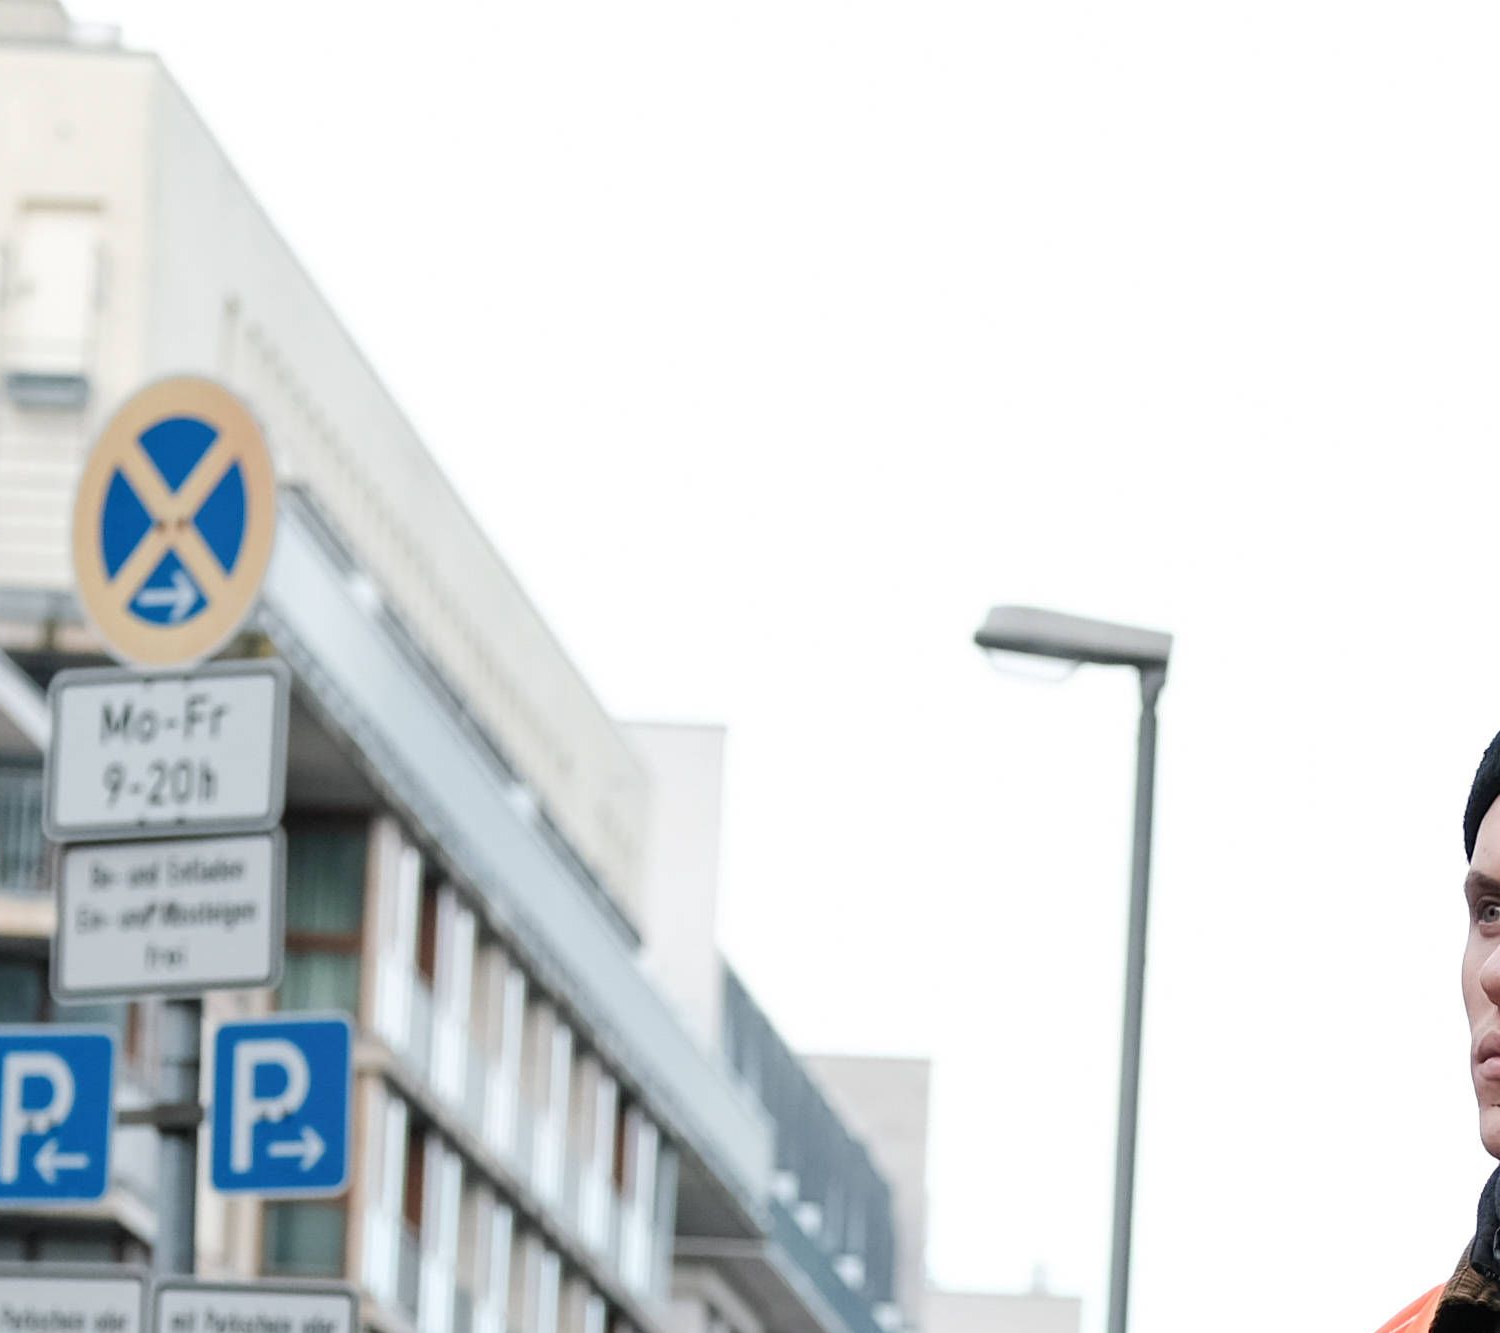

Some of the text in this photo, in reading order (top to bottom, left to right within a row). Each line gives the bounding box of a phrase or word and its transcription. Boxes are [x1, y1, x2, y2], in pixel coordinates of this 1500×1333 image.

[101, 693, 228, 742] Mo-Fr
[102, 758, 218, 808] 9-20h
[231, 1039, 310, 1173] P
